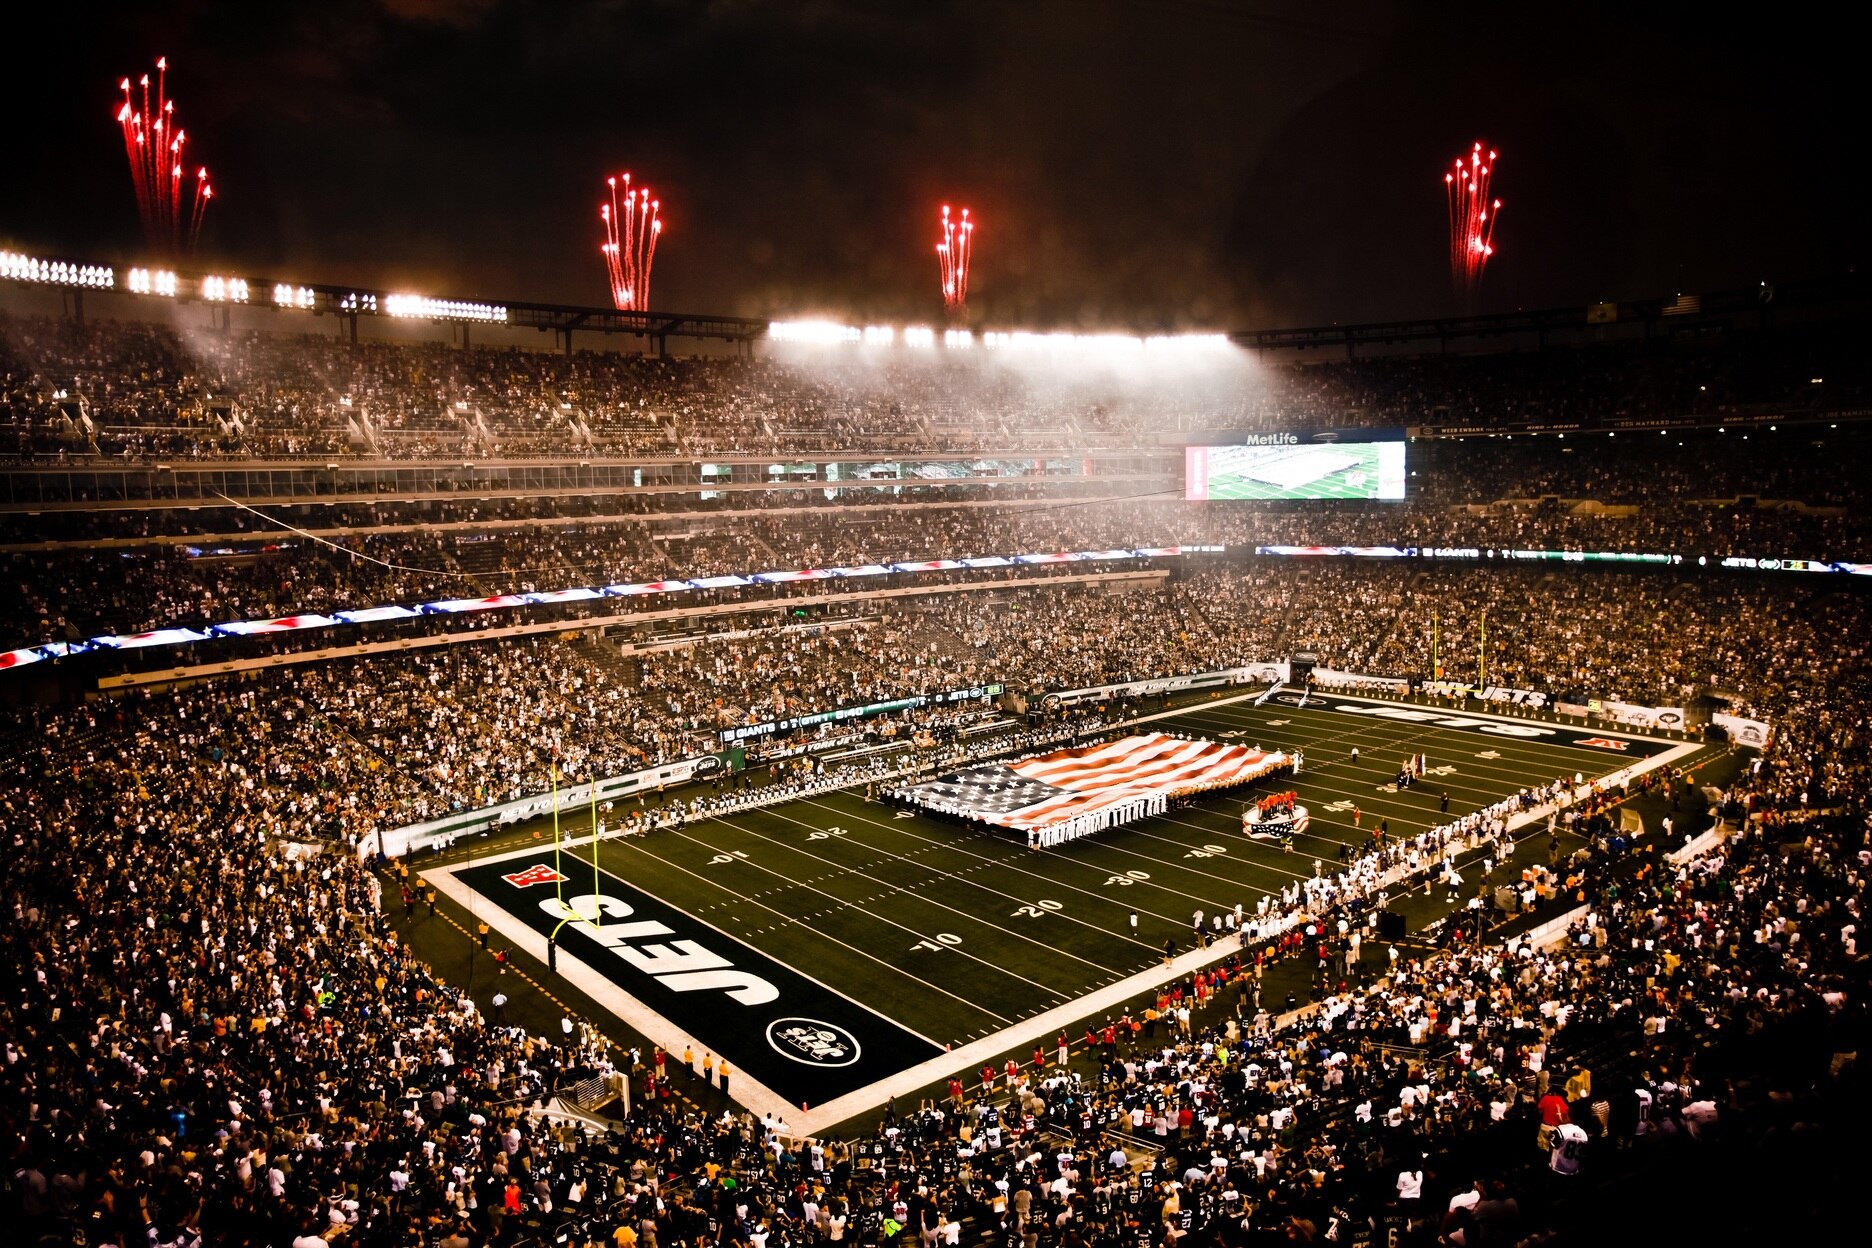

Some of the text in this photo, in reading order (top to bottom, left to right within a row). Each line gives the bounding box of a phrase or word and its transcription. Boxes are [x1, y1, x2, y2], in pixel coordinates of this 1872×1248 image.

[1247, 433, 1298, 446] MetLife
[1434, 548, 1480, 557] GIANTS
[1721, 557, 1757, 569] JETS
[1170, 679, 1193, 688] JETS
[948, 690, 969, 701] JETS
[1474, 685, 1547, 707] JETS
[1335, 705, 1556, 737] JETS
[736, 722, 776, 739] GIANTS
[806, 739, 837, 753] YORK
[499, 802, 535, 820] NEW
[808, 826, 848, 840] 20
[711, 850, 750, 864] 10
[1193, 844, 1227, 860] 40
[1108, 869, 1151, 887] 30
[1018, 899, 1064, 919] 20
[918, 932, 963, 952] 10
[538, 894, 780, 1006] JETS
[751, 1170, 759, 1180] 57
[823, 1176, 831, 1185] 10
[1143, 1178, 1153, 1188] 12
[709, 1221, 717, 1231] 10
[1033, 1214, 1043, 1224] 26
[1181, 1218, 1191, 1229] 27
